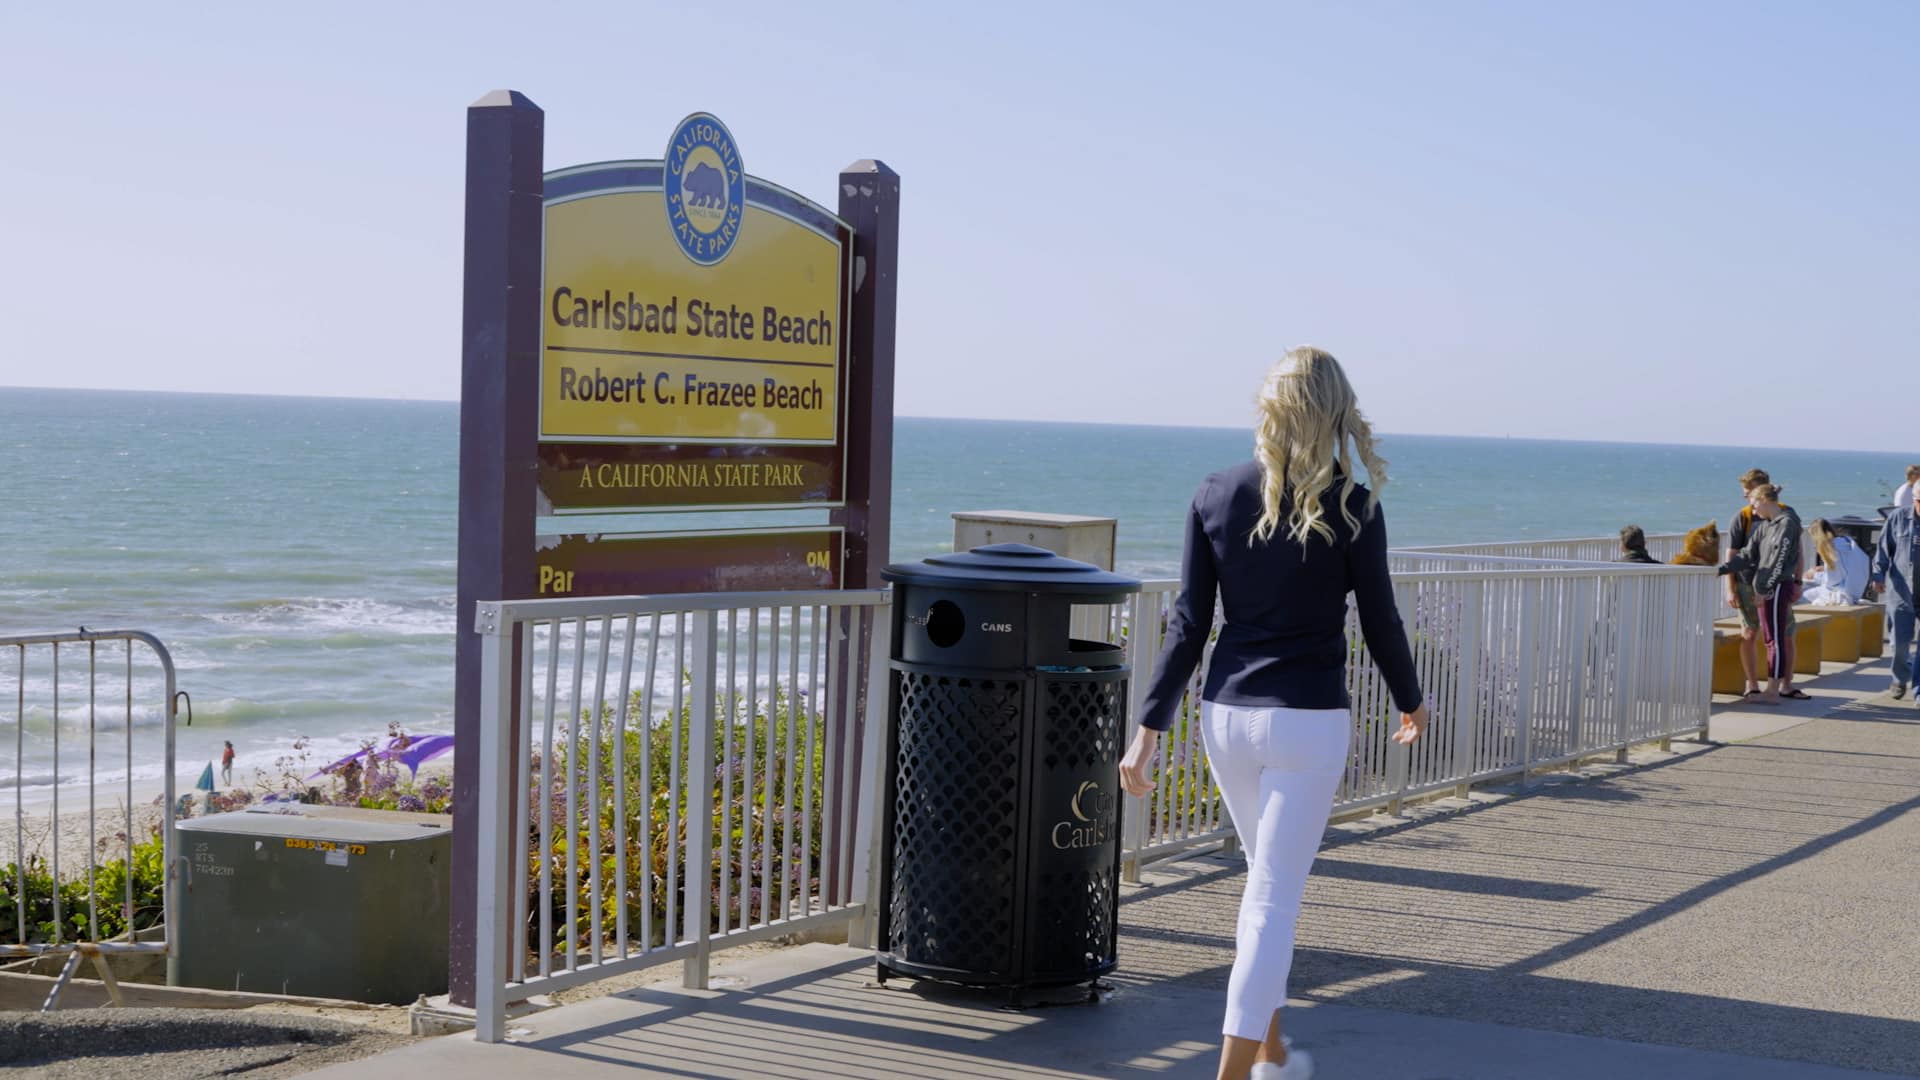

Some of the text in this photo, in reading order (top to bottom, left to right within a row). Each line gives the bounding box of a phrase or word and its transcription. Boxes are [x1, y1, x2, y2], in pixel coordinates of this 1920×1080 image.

[671, 124, 740, 185] CALIFORNIA
[670, 193, 740, 256] STATE PARKS
[552, 286, 832, 346] Carlsbad State Beach
[559, 366, 823, 410] Robert C. Frazee Beach
[579, 463, 805, 488] A CALIFORNIA STATE PARK
[539, 565, 575, 594] Par
[981, 621, 1013, 634] CANS
